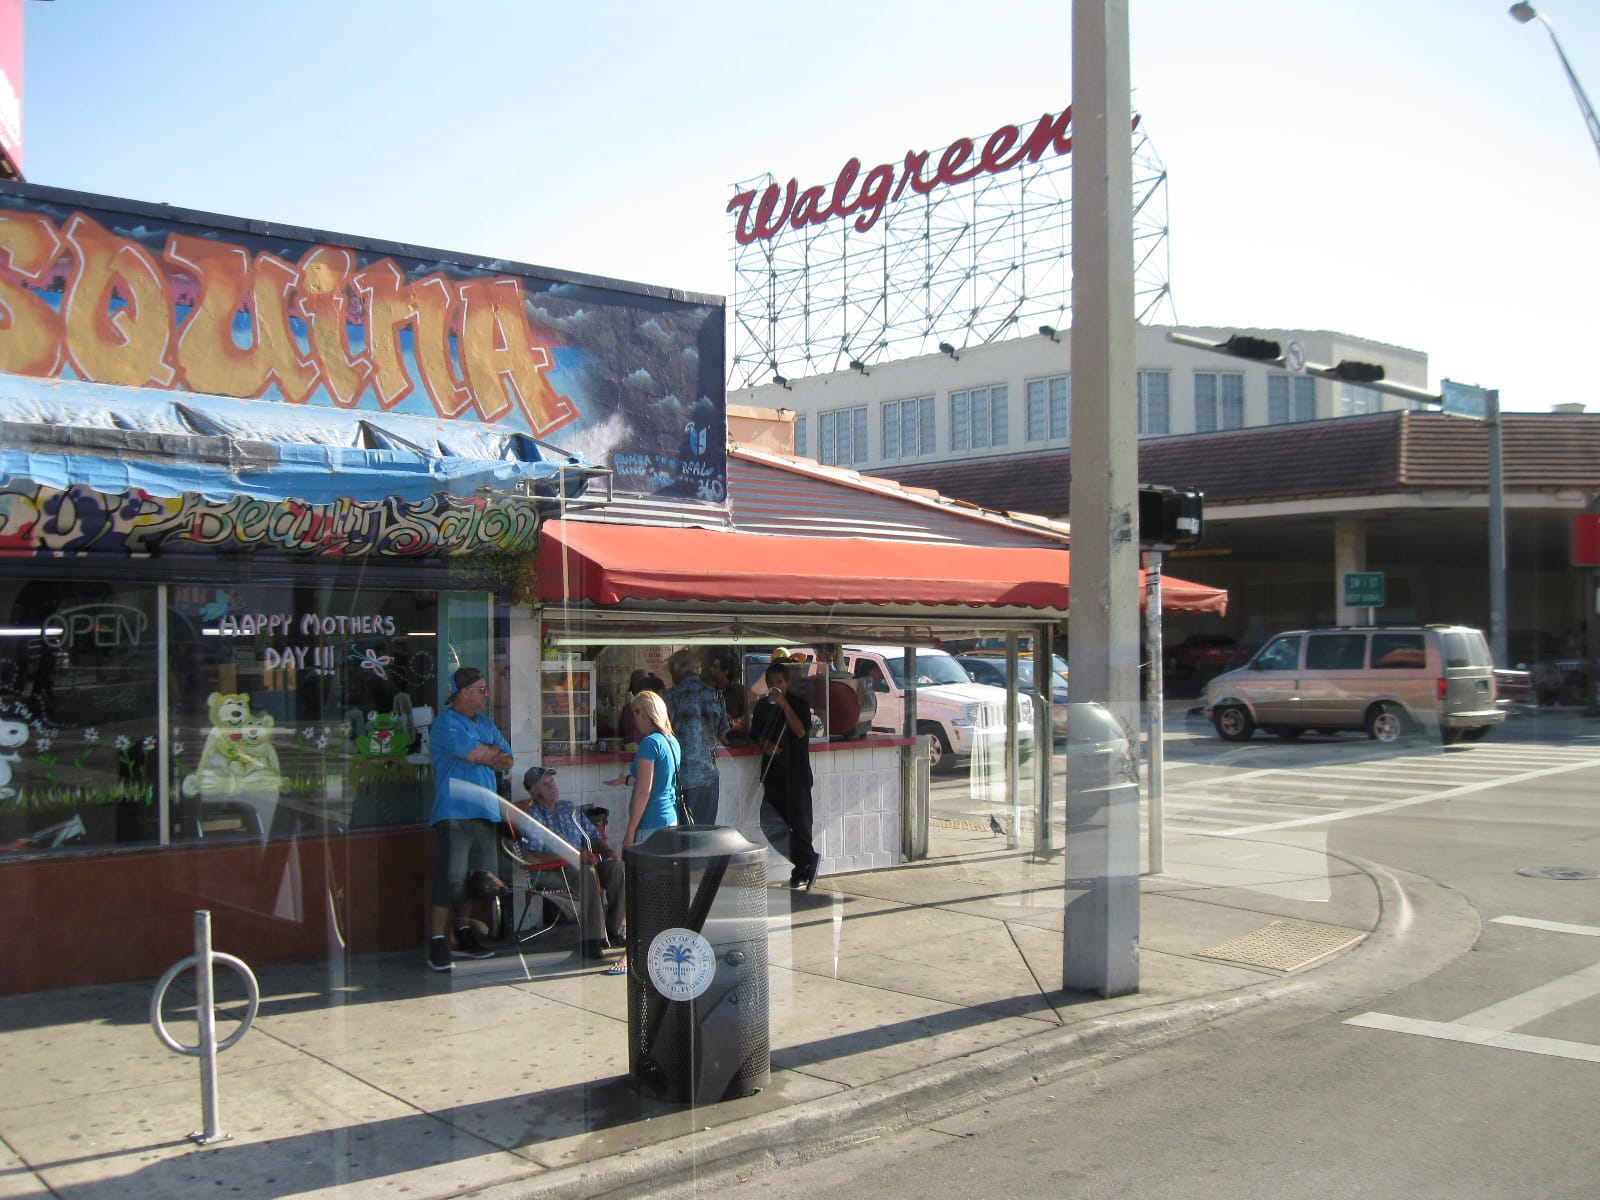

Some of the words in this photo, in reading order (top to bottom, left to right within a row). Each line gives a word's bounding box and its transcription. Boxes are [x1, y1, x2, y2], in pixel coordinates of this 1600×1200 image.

[726, 104, 1140, 246] Walgreen
[162, 493, 383, 558] Beauty
[380, 490, 542, 558] Salon
[43, 613, 141, 648] OPEN
[219, 614, 293, 637] HAPPY
[302, 613, 397, 637] MOTHERS
[661, 936, 676, 946] CITY
